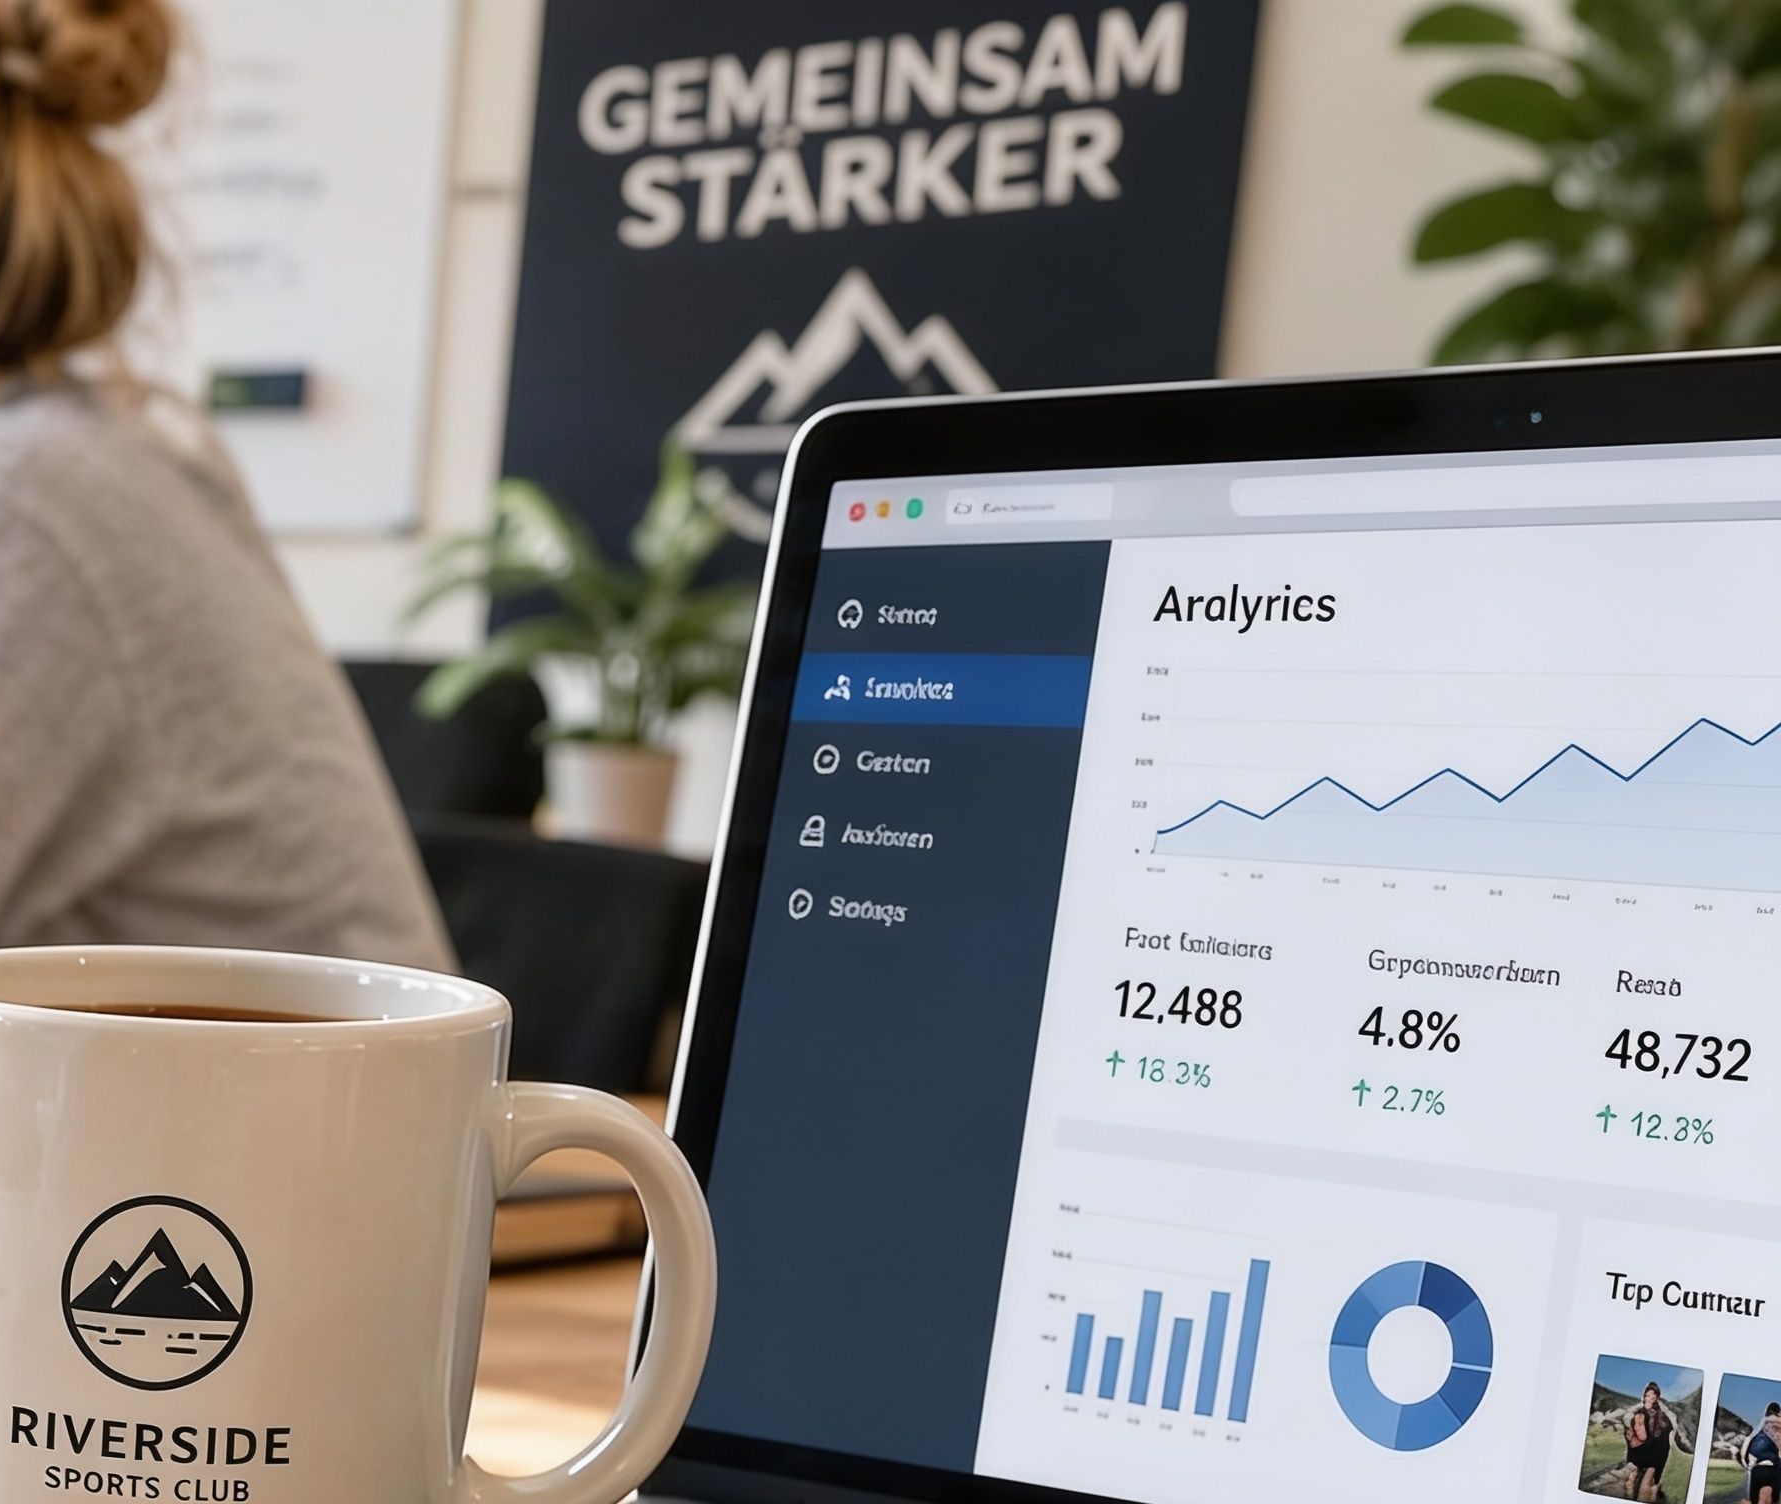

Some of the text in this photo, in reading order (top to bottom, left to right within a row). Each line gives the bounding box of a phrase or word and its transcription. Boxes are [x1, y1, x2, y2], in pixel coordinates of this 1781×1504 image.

[578, 2, 1188, 155] GEMEINSAM
[617, 109, 1125, 250] STÄRKER
[1358, 1006, 1460, 1052] 4.8%
[1605, 1029, 1751, 1081] 48,732
[1382, 1086, 1445, 1115] 2.7%
[11, 1406, 291, 1465] RIVERSIDE
[45, 1466, 249, 1502] SPORTS CLUB
